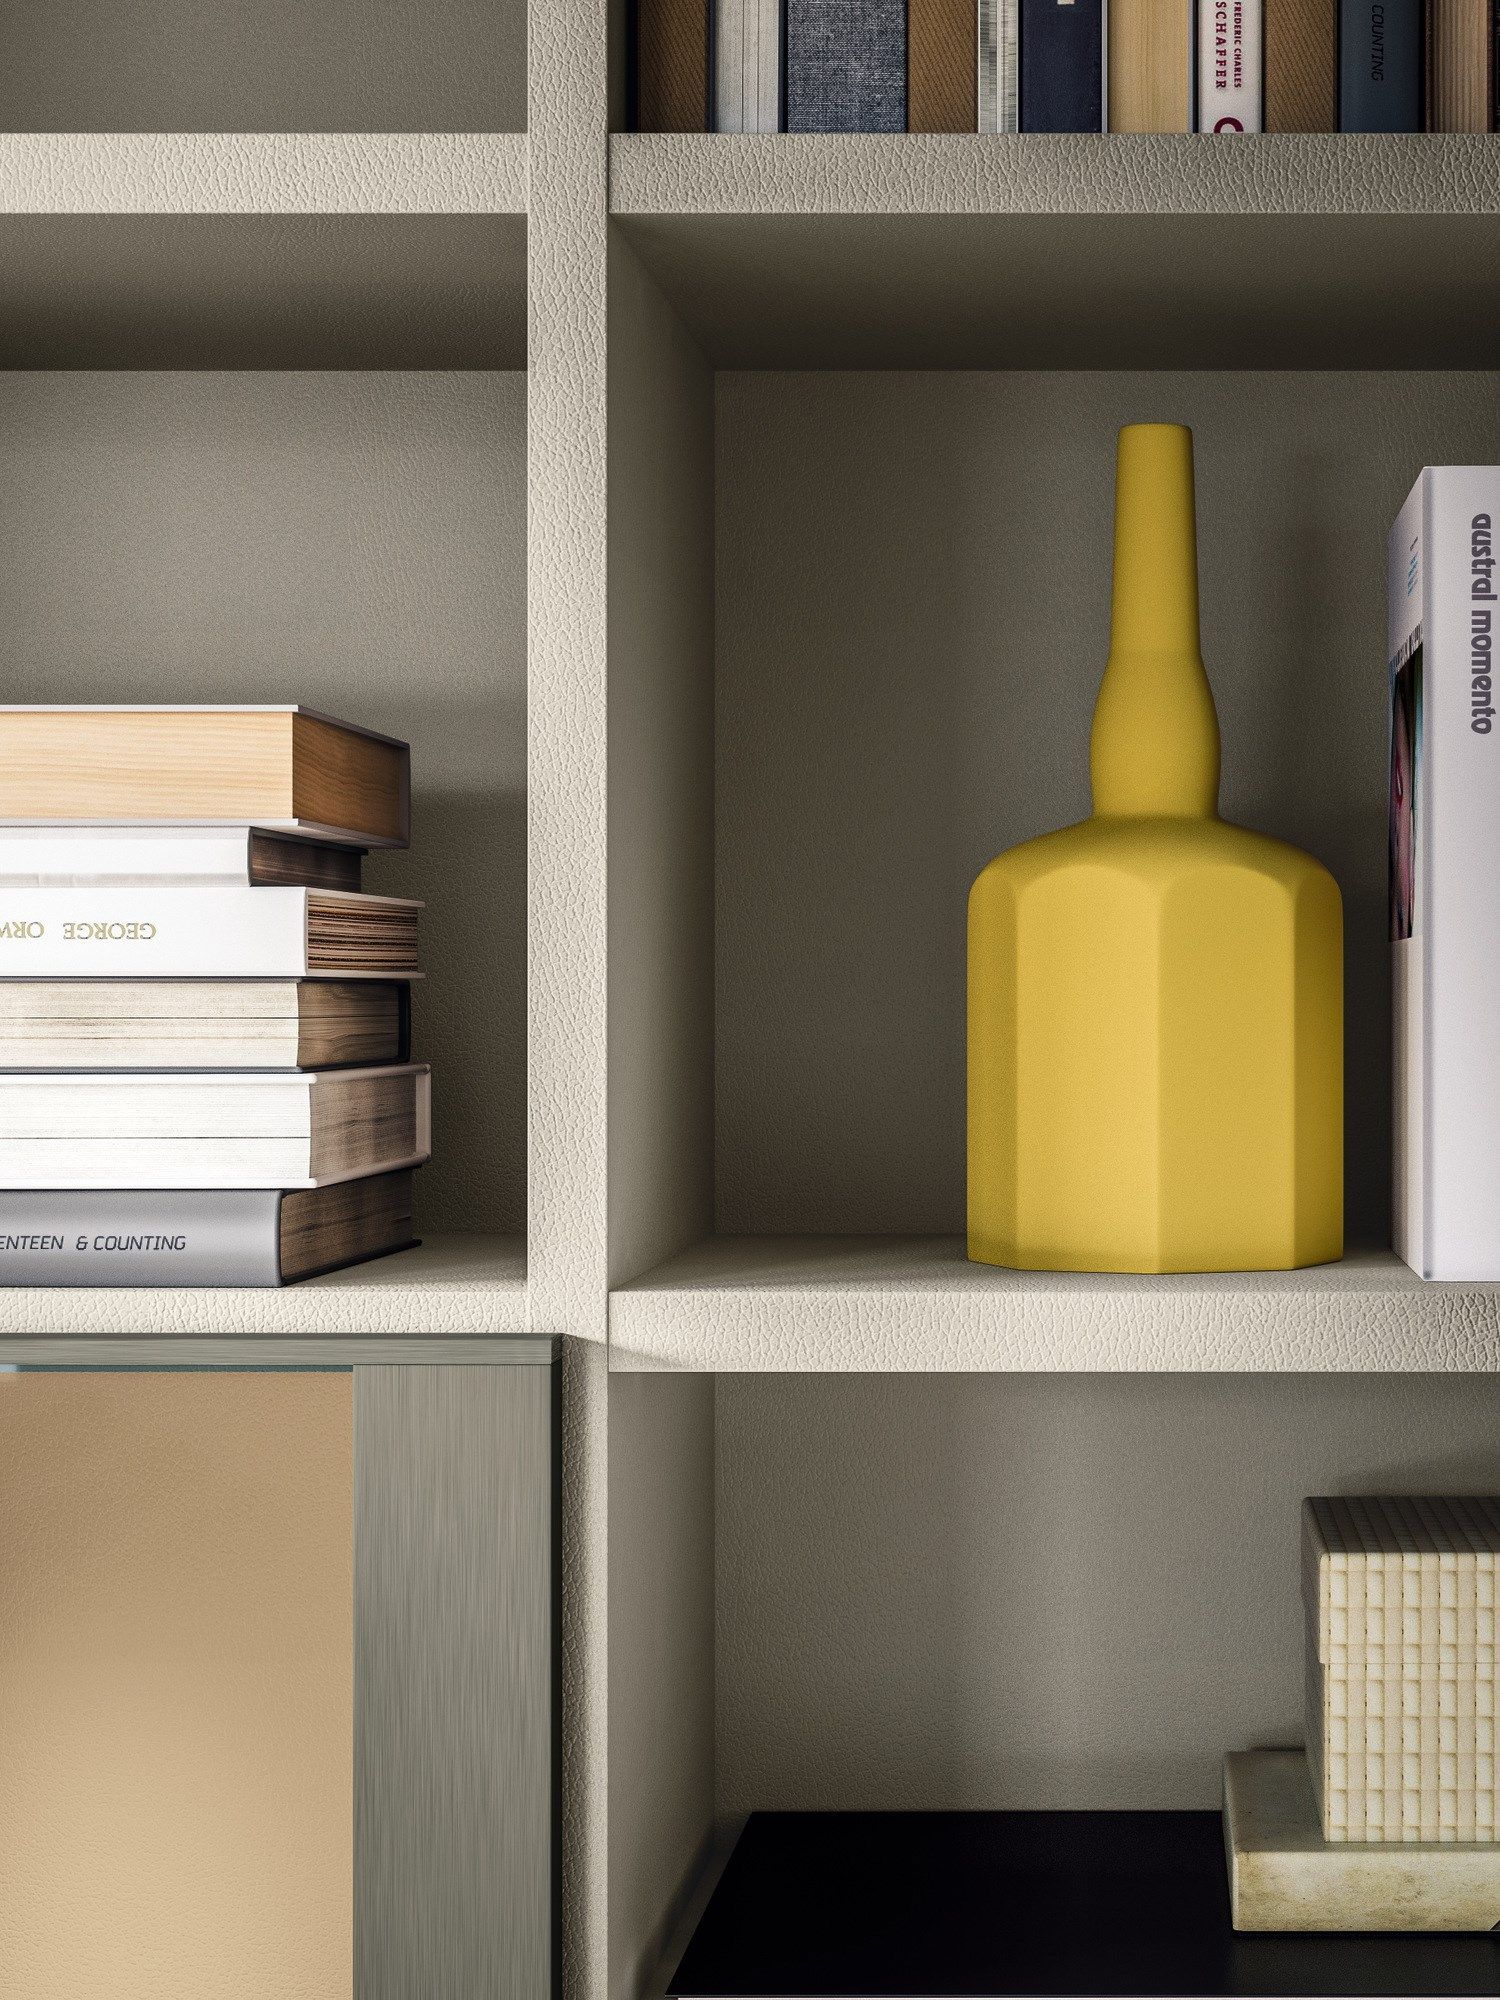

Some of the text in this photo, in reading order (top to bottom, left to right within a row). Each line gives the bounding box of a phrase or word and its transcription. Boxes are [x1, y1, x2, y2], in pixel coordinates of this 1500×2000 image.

[1215, 1, 1227, 89] SCHAFFER
[1233, 1, 1242, 88] FREDERIC CHARLES
[1370, 4, 1385, 81] COUNTING
[1470, 513, 1498, 735] austral momento
[62, 922, 157, 940] GEORGE
[75, 1235, 89, 1251] &
[93, 1235, 187, 1251] COUNTING
